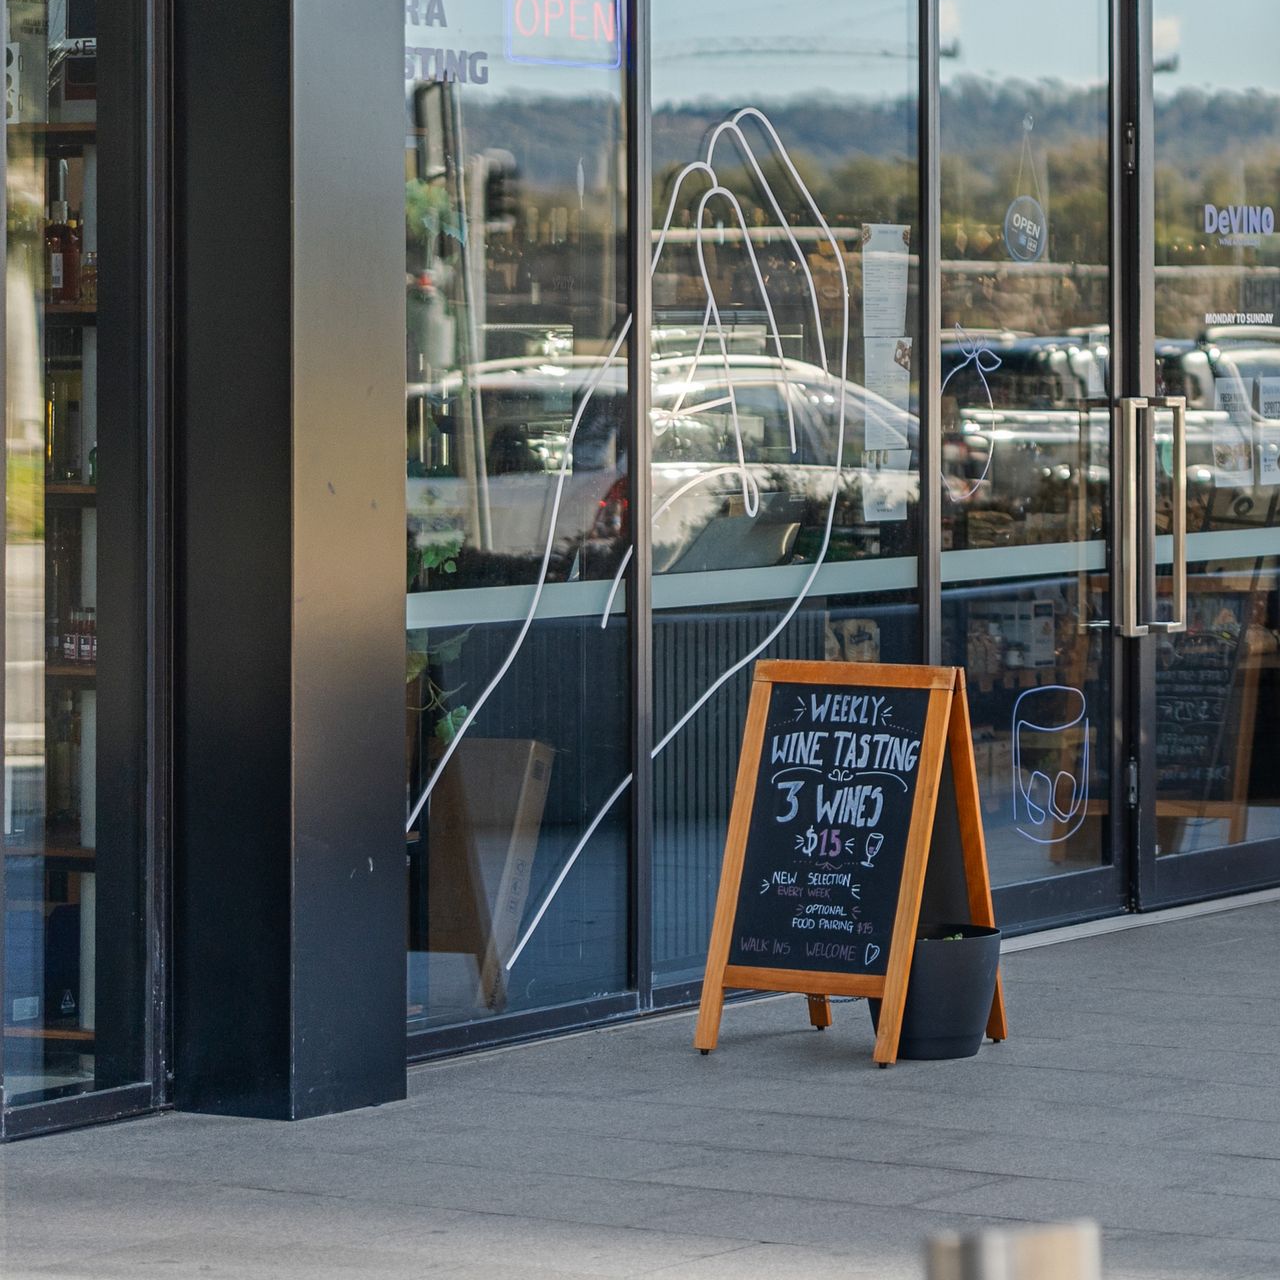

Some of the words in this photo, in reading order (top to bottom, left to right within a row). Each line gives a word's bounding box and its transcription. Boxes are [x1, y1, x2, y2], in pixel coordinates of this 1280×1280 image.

[1012, 212, 1041, 239] OPEN
[1204, 203, 1275, 236] DeVINO
[1205, 312, 1235, 324] MONDAY
[1236, 312, 1246, 324] TO
[1246, 312, 1274, 324] SUNDAY
[811, 693, 886, 726] WEEKLY
[771, 731, 829, 766] WINE
[834, 730, 921, 772] TASTING
[776, 780, 805, 823] 3
[816, 784, 884, 828] WINES
[802, 825, 842, 857] $15
[772, 871, 798, 885] NEW
[808, 872, 852, 887] SELECTION
[777, 886, 803, 897] EVERY
[807, 887, 831, 899] WEEK
[805, 904, 847, 916] OPTIONAL
[792, 918, 815, 929] FOOD
[818, 918, 854, 933] PAIRING
[740, 937, 768, 952] WALK
[772, 938, 791, 955] INS
[806, 942, 857, 961] WELCOME
